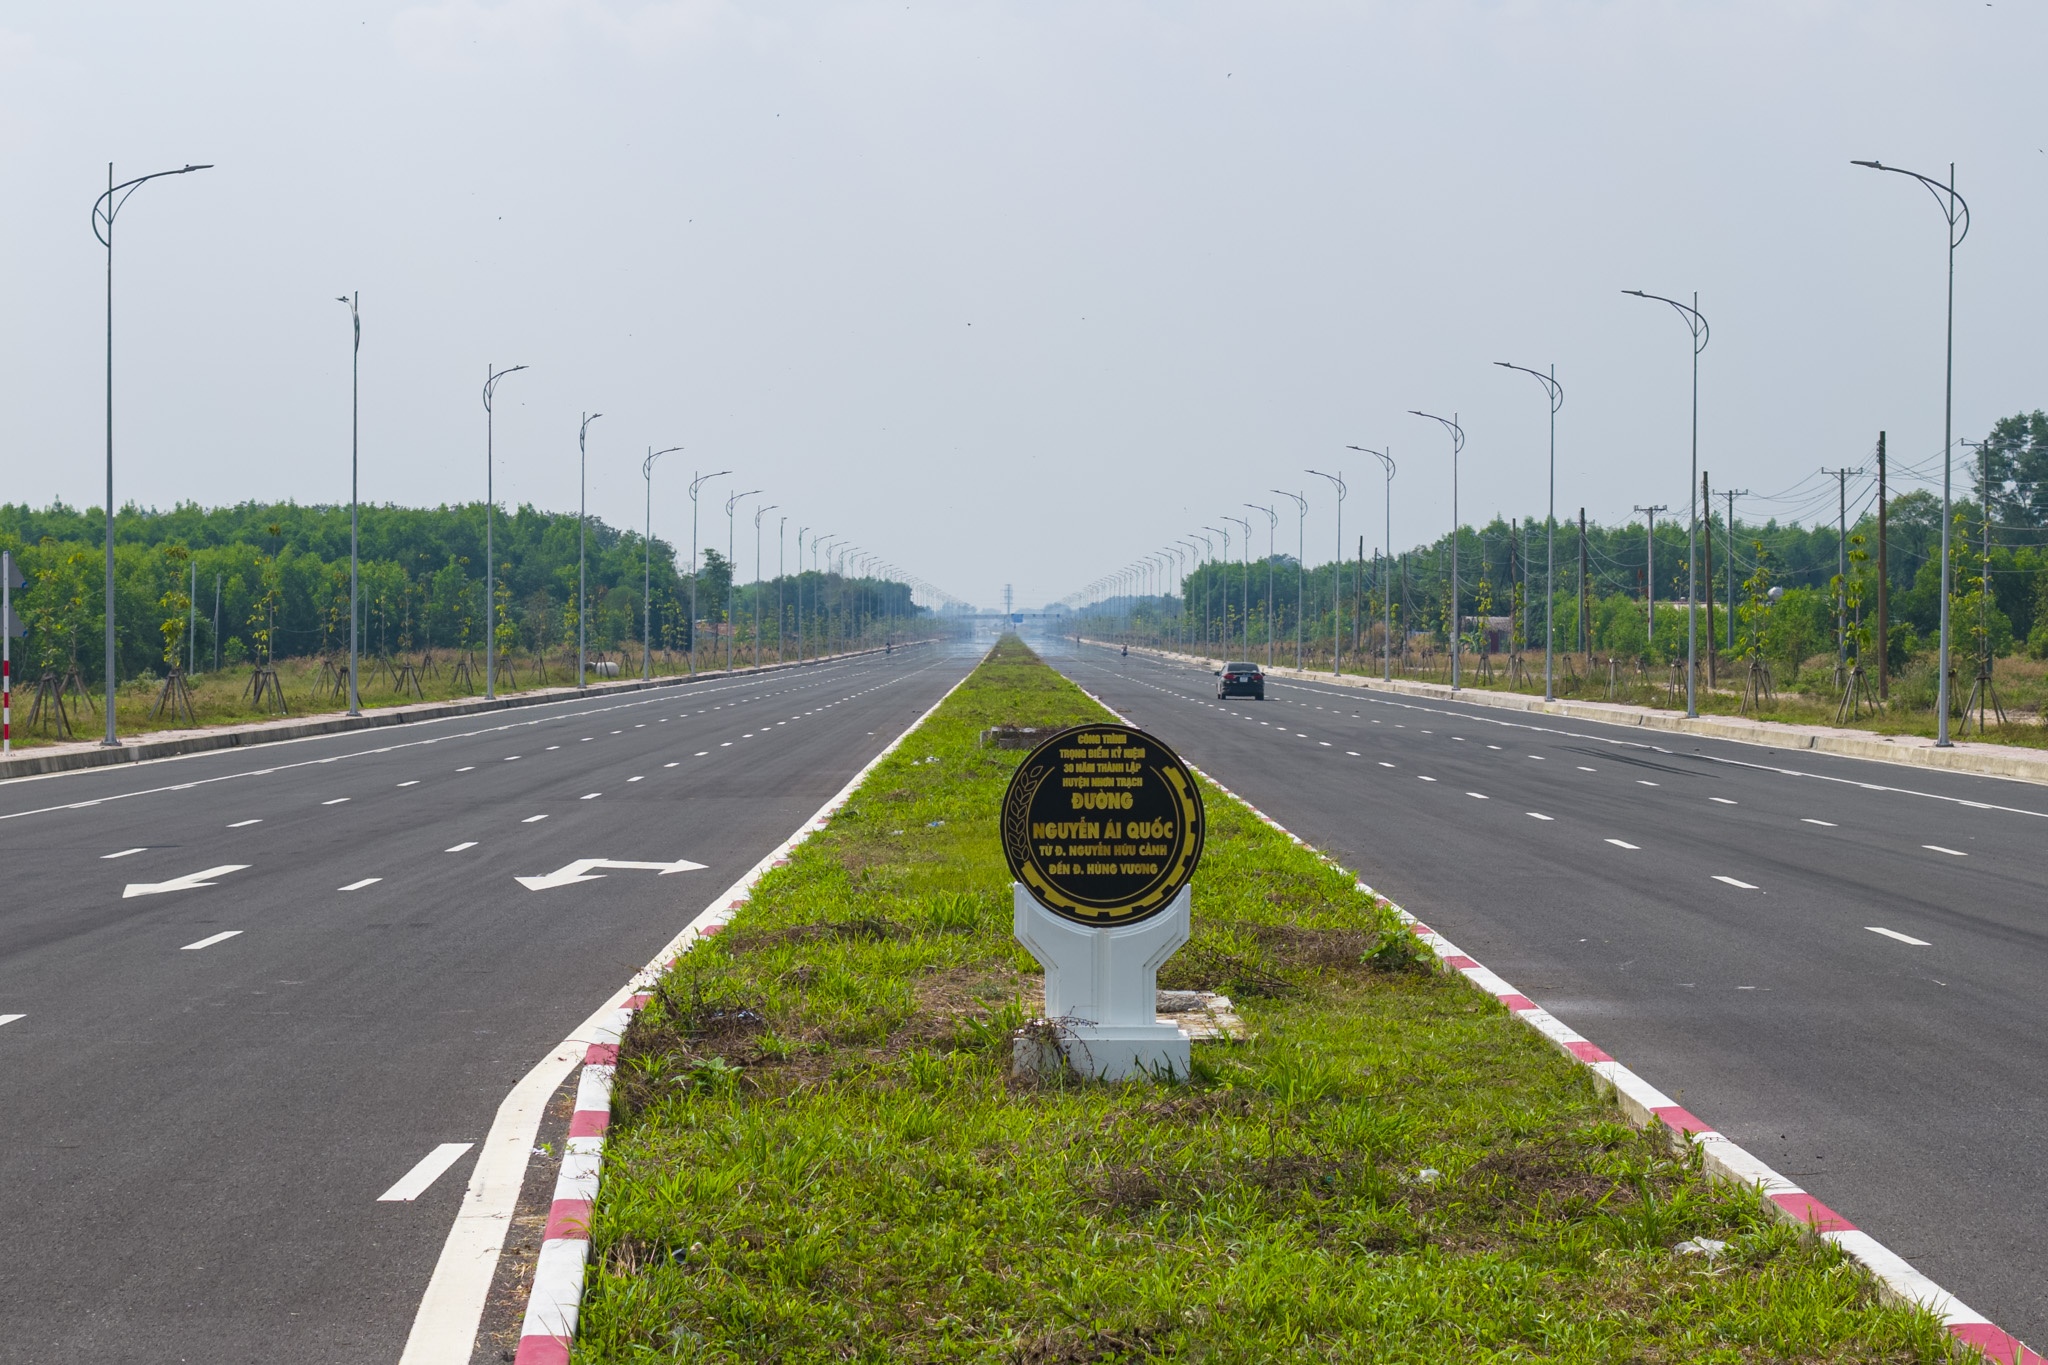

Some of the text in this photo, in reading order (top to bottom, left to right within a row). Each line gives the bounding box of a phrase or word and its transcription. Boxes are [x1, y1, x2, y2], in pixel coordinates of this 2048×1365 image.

[1063, 761, 1142, 774] 30 NĂM THÀNH LẬP
[1062, 776, 1090, 788] HUYỆN
[1116, 777, 1143, 788] TRẠCH
[1071, 789, 1134, 810] ĐƯỜNG
[1032, 816, 1174, 840] NGUYỄN ÁI QUỐC
[1039, 843, 1053, 856] TỪ
[1054, 845, 1067, 856] Đ.
[1069, 842, 1111, 856] NGUYỄN
[1139, 842, 1168, 856] CẢNH
[1048, 860, 1158, 875] ĐẾN Đ. HÙNG VƯƠNG
